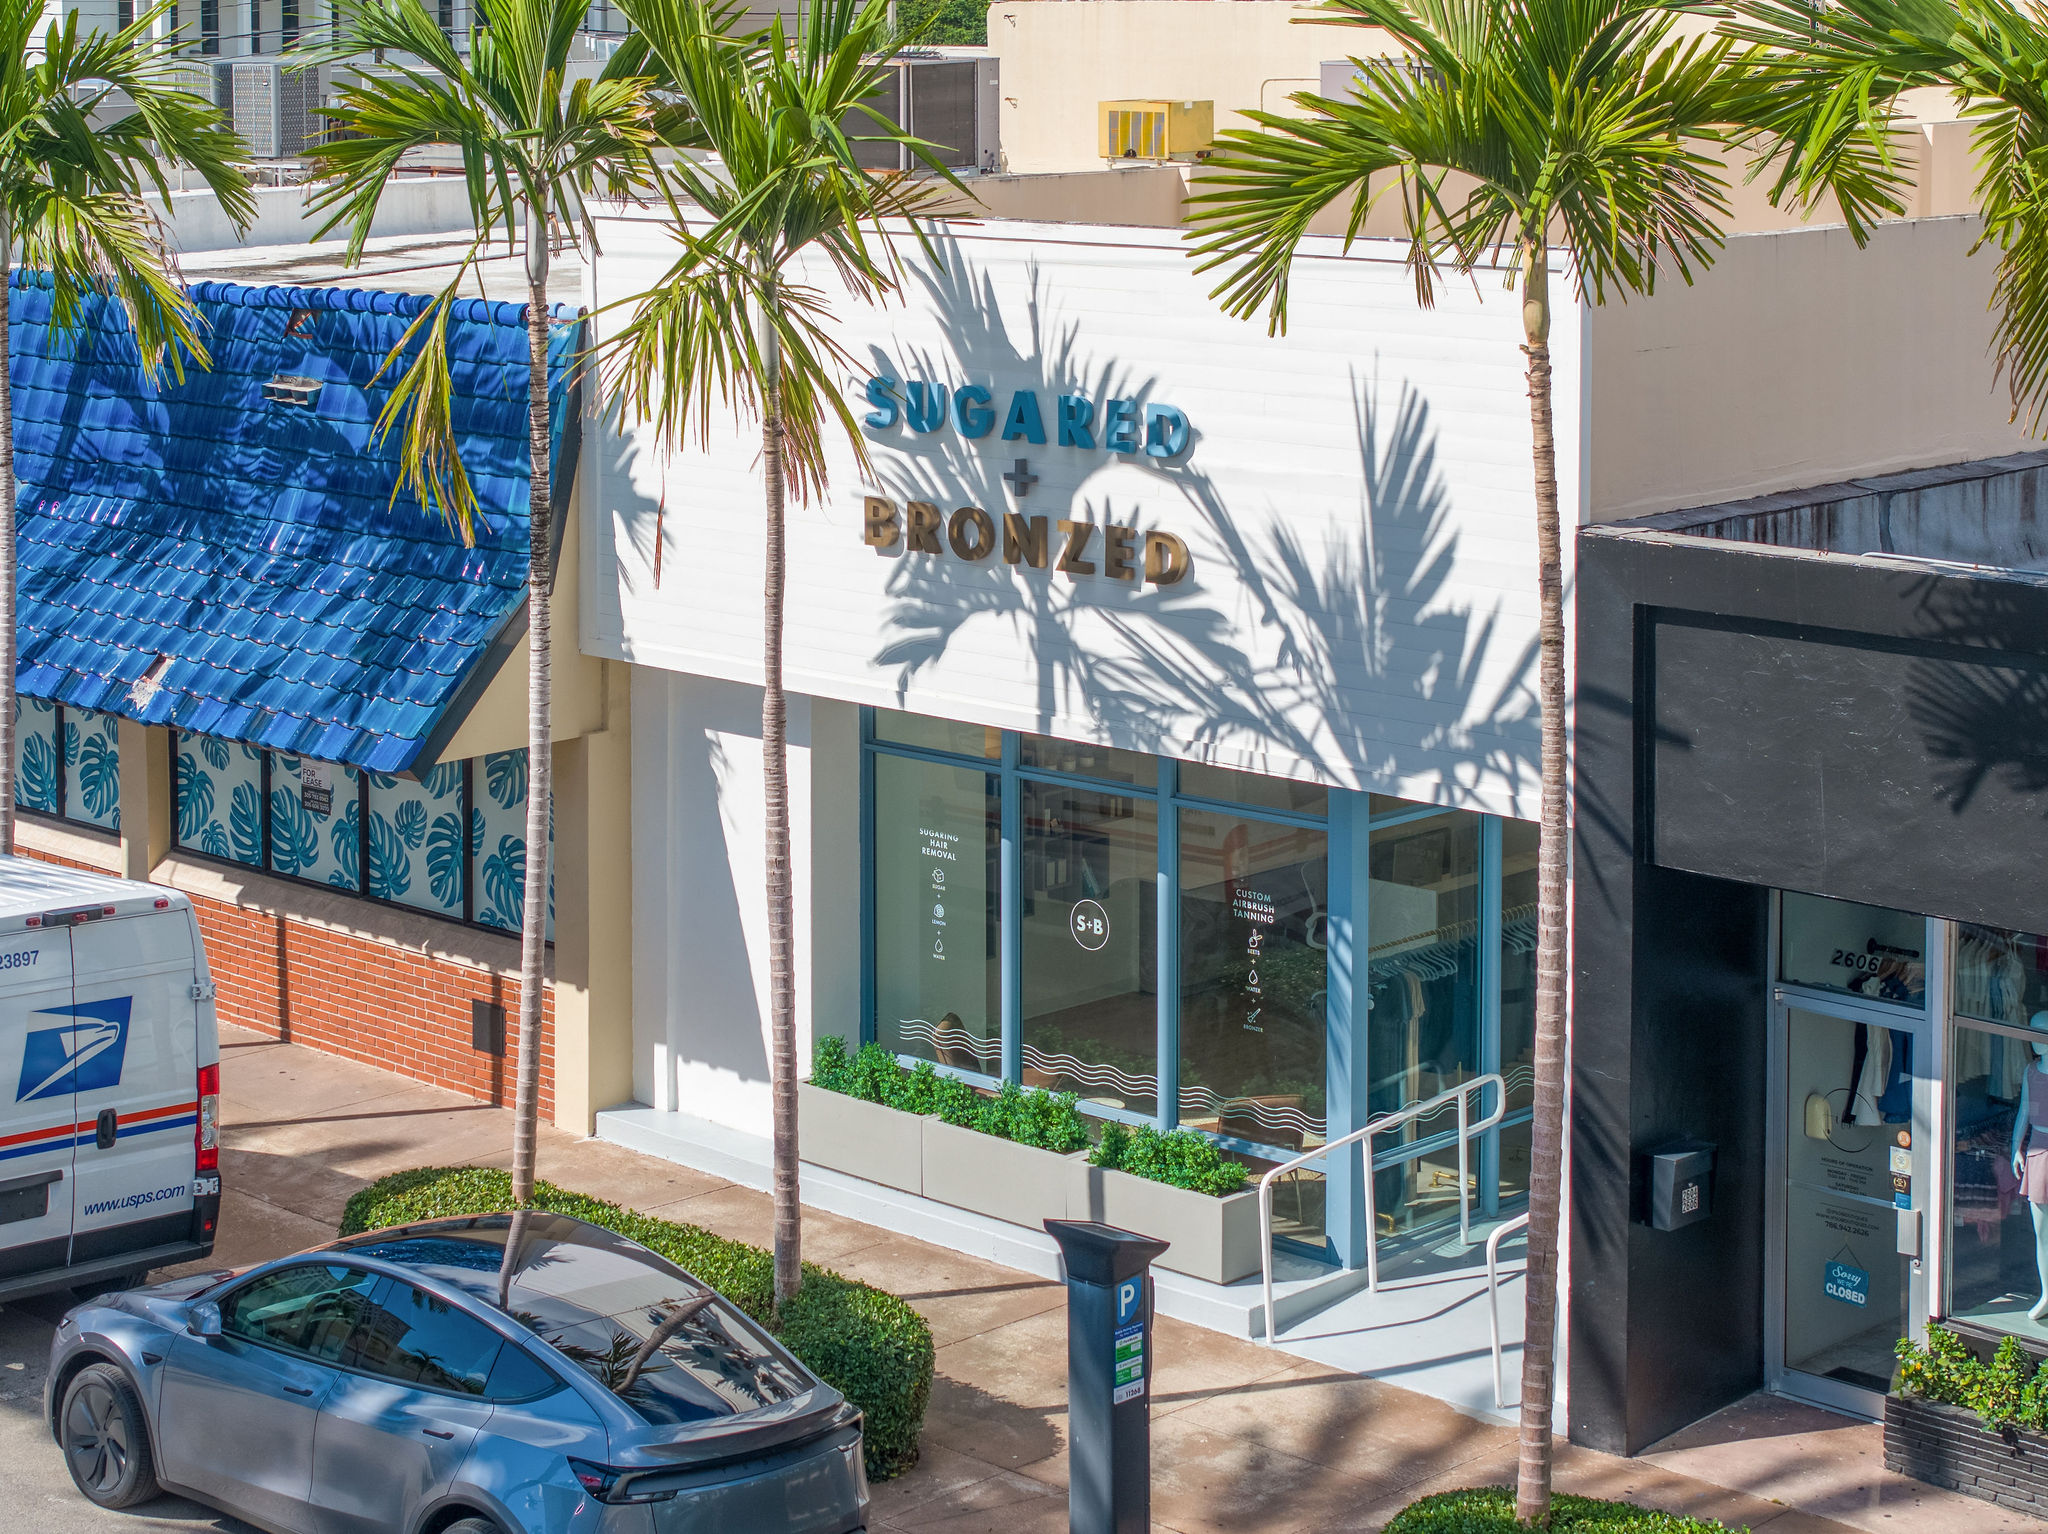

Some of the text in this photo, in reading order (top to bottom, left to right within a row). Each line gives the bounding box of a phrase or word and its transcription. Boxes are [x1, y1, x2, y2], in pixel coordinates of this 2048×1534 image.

[864, 376, 1190, 459] SUGARED
[864, 495, 1190, 585] BRONZED
[303, 768, 315, 778] FOR
[303, 776, 322, 787] LEASE
[919, 827, 959, 842] SUGARING
[930, 839, 948, 850] HAIR
[921, 847, 957, 861] REMOVAL
[1235, 888, 1271, 903] CUSTOM
[1232, 899, 1275, 914] AIRBRUSH
[1233, 908, 1274, 924] TANNING
[0, 950, 39, 970] 23897
[1831, 949, 1880, 972] 2606
[84, 1185, 185, 1216] www.usps.com
[1832, 1265, 1862, 1287] Sorry
[1120, 1284, 1135, 1318] P
[1825, 1282, 1866, 1305] CLOSED
